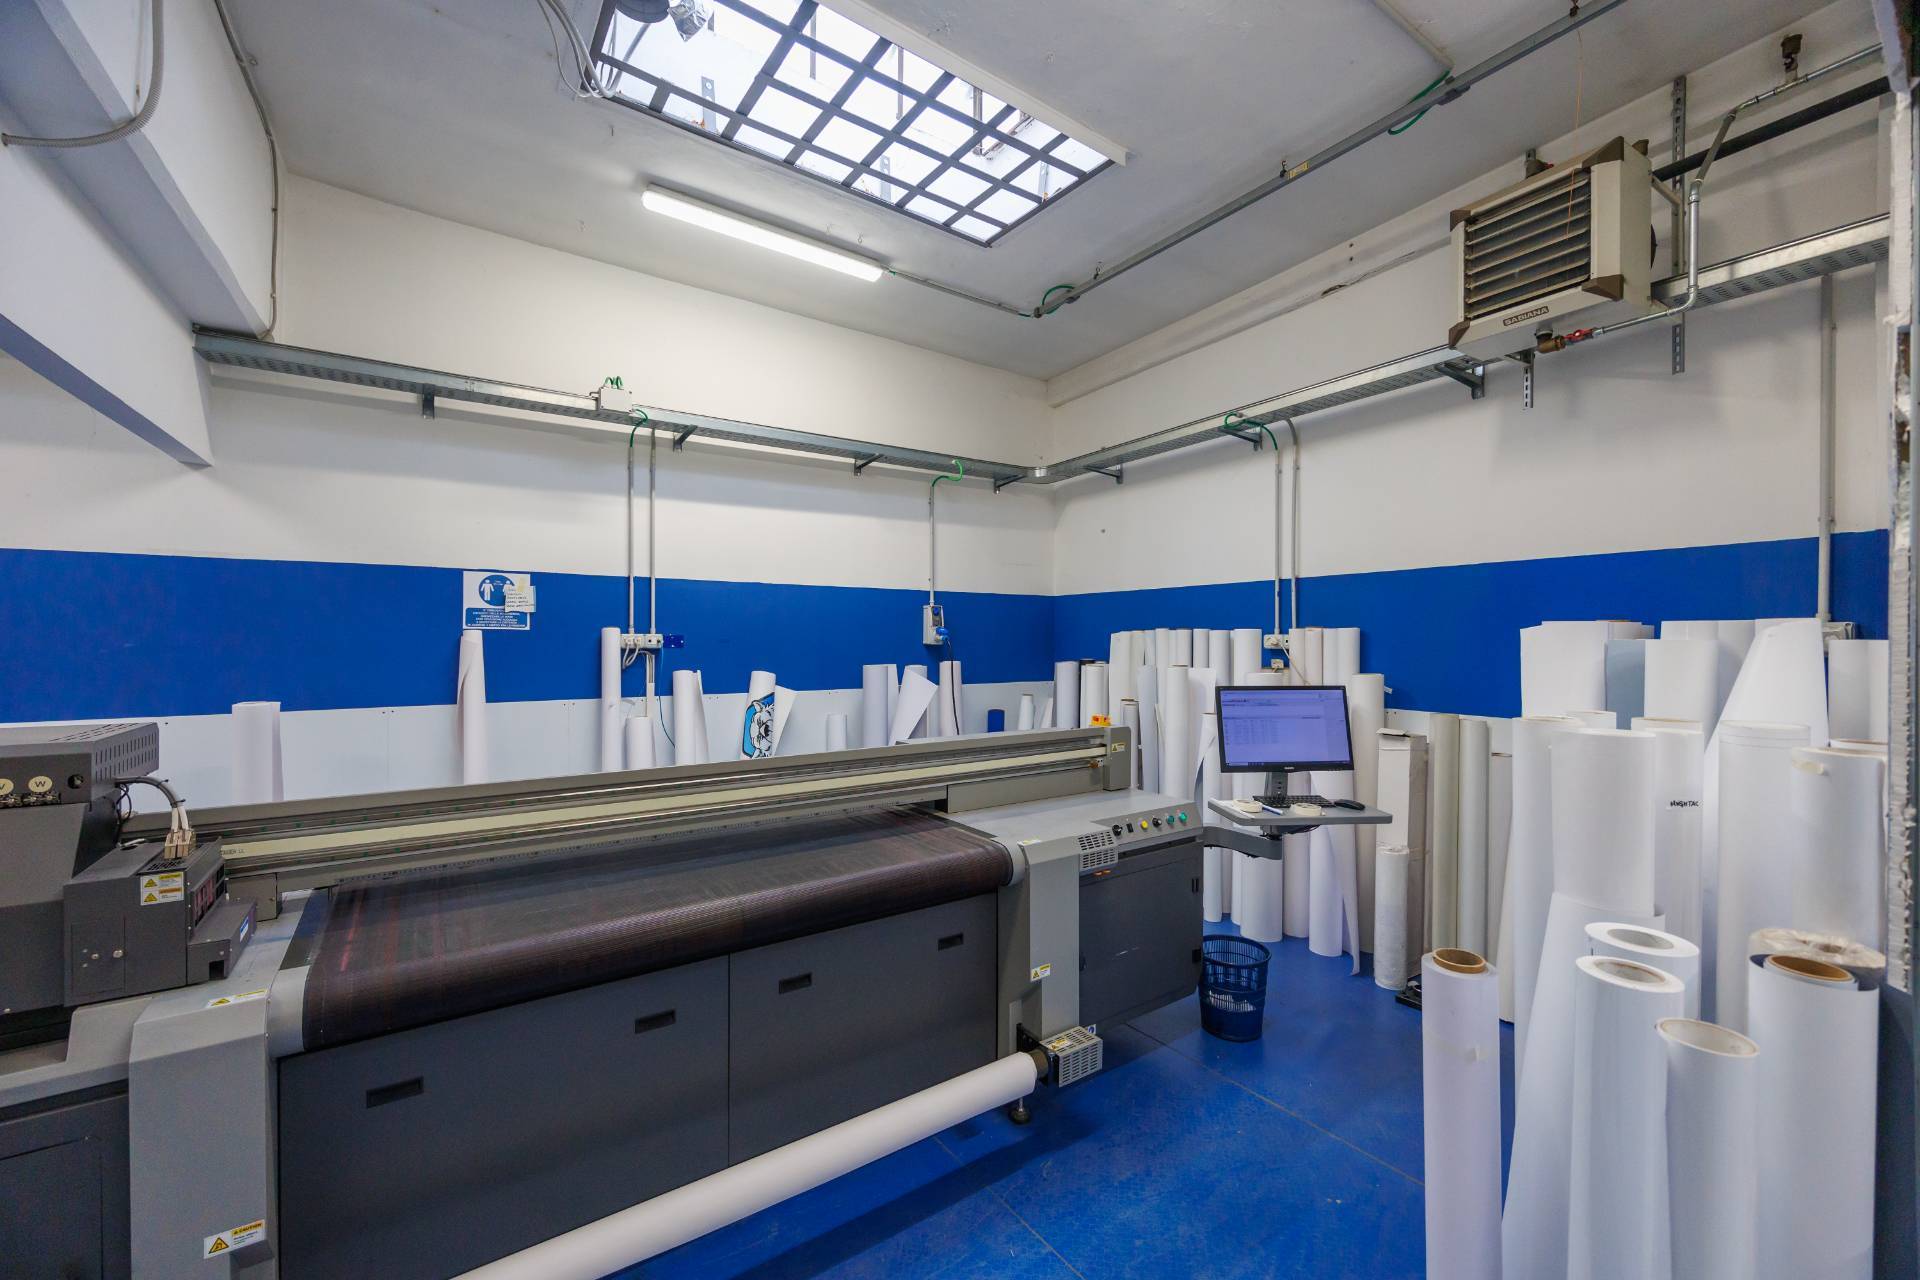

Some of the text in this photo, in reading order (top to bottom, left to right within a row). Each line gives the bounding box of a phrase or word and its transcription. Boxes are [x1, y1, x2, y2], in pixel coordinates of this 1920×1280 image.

[1503, 306, 1548, 326] SABIANA
[35, 780, 46, 788] W
[239, 1223, 262, 1233] CAUTION
